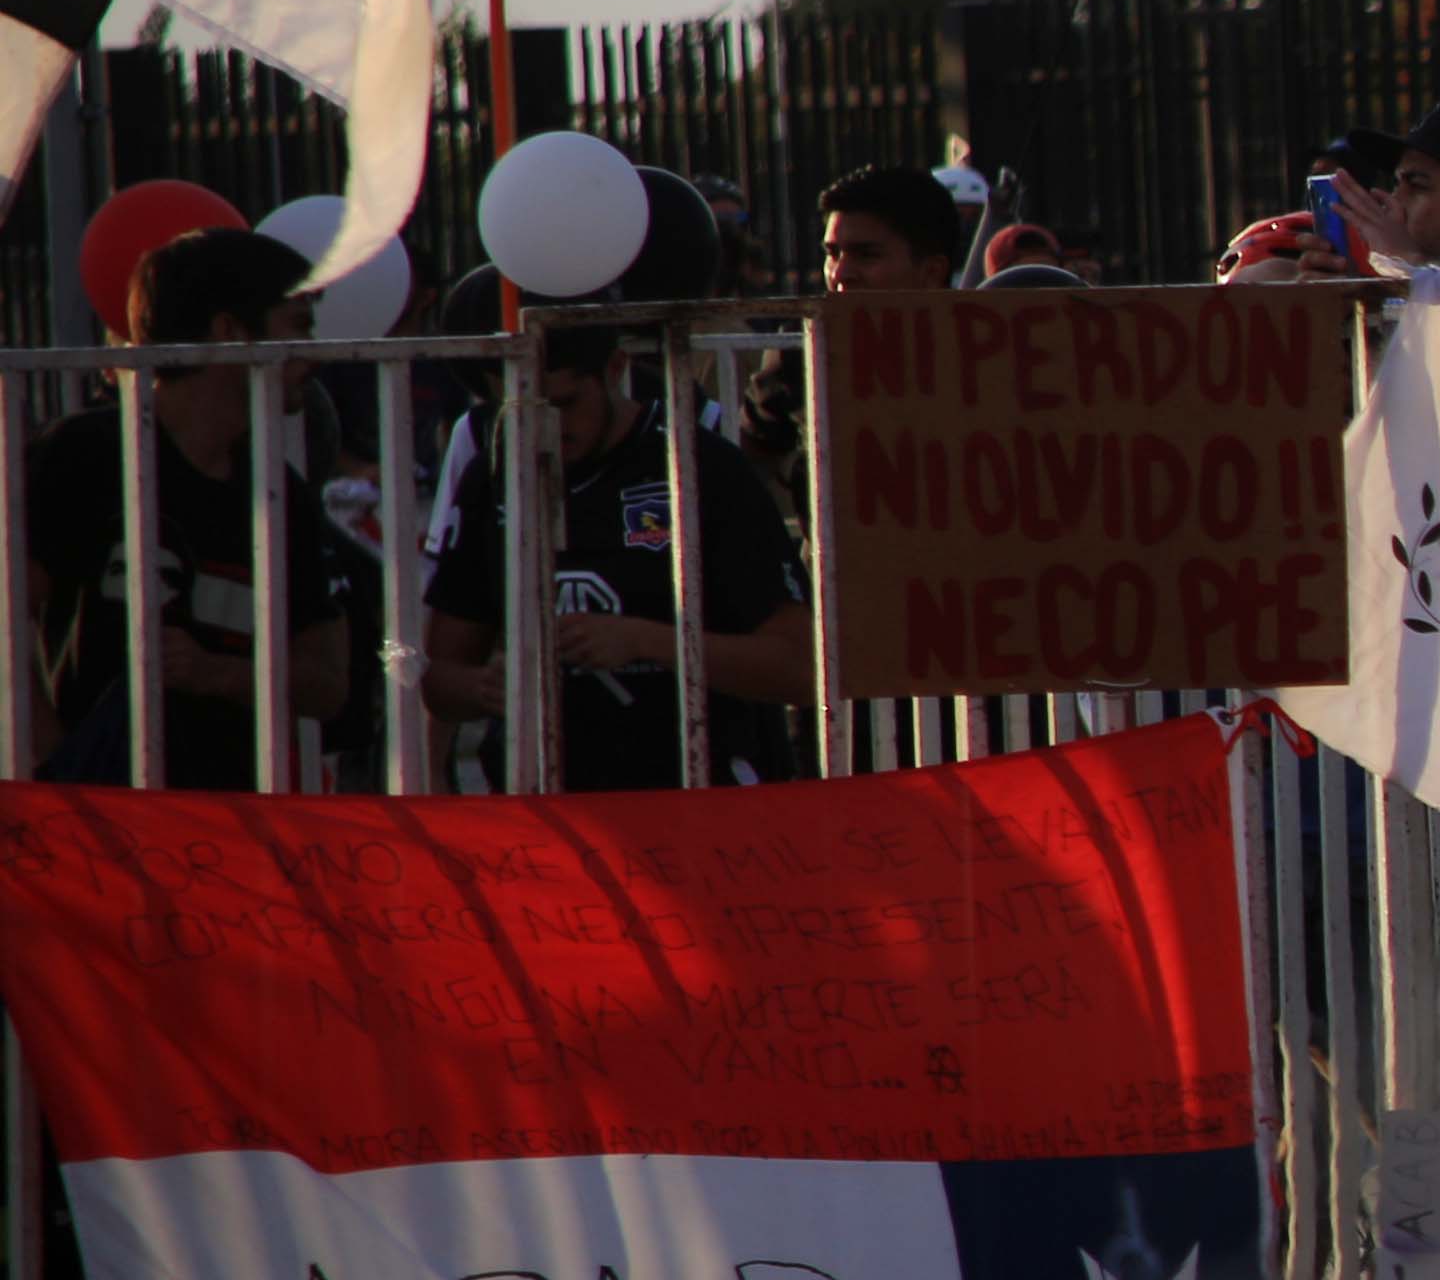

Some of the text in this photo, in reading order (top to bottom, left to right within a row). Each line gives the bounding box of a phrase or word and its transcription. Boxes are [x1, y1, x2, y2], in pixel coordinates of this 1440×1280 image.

[850, 303, 936, 400] NI
[854, 425, 949, 531] NI
[905, 559, 1158, 680] NECO
